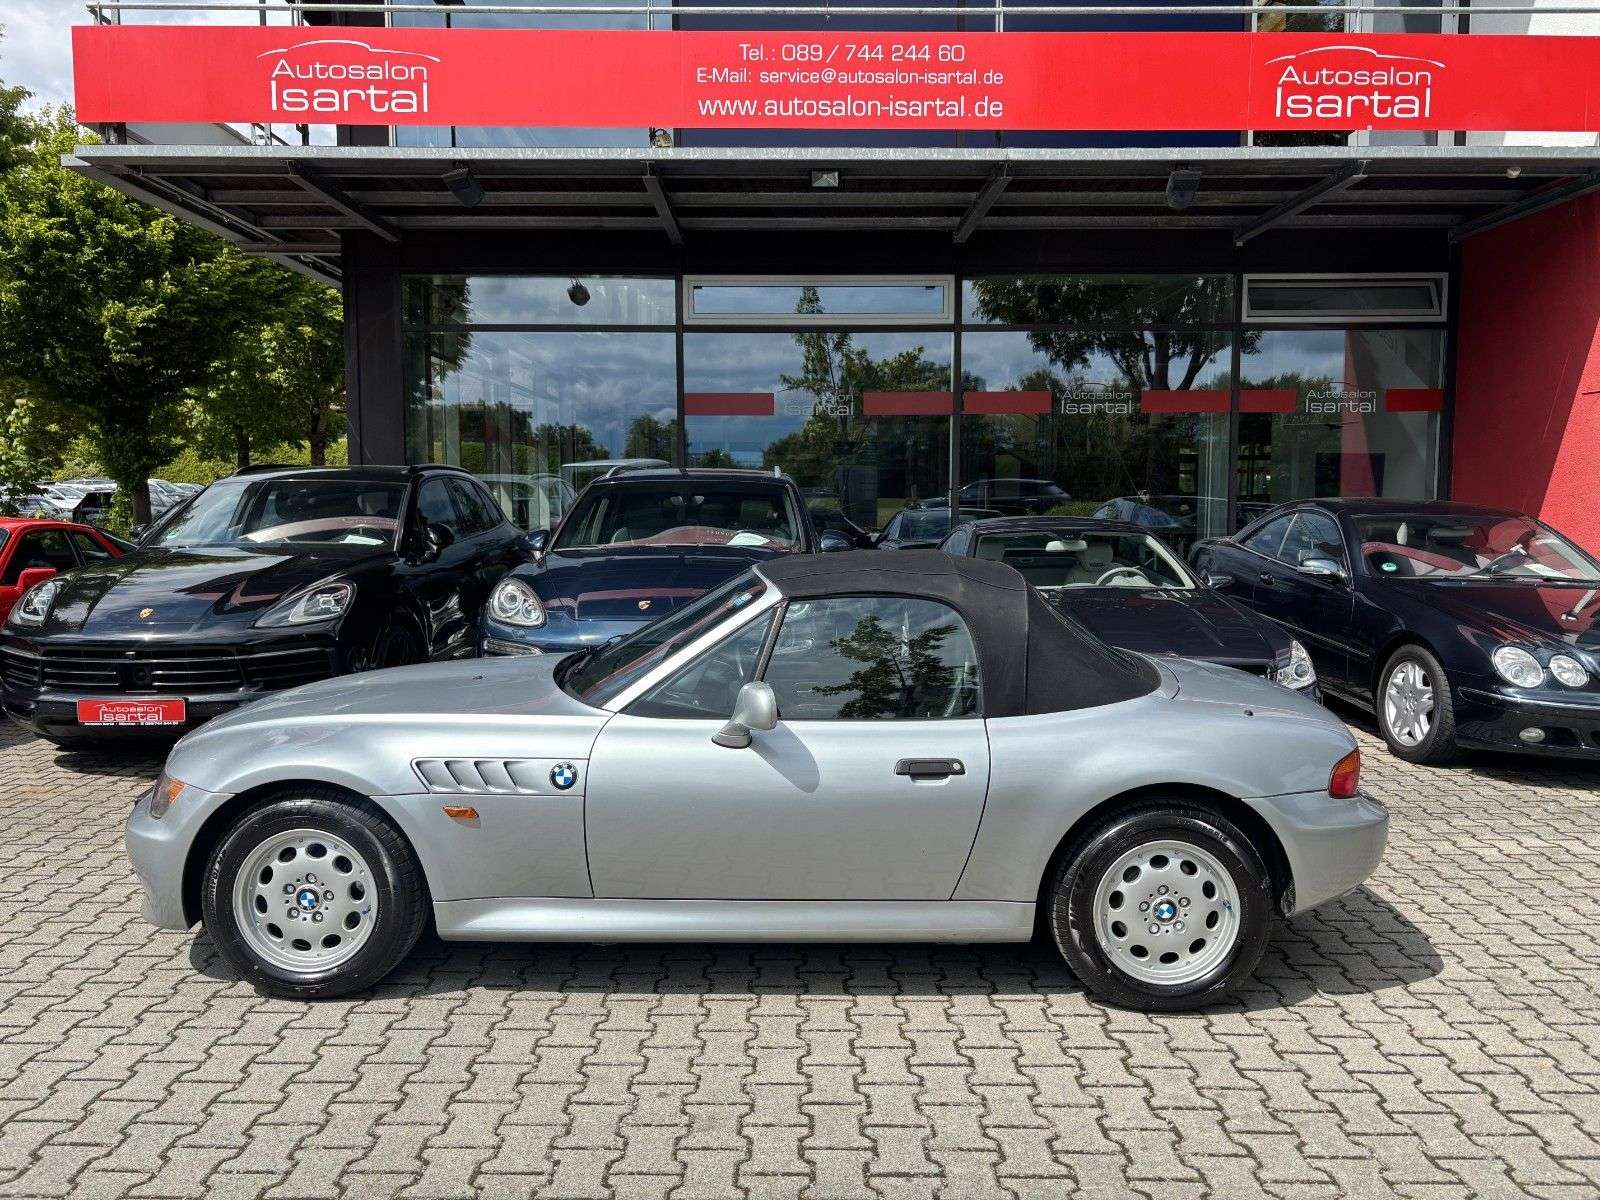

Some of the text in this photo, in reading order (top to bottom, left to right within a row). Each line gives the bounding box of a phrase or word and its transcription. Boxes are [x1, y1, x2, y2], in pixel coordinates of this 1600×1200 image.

[739, 43, 776, 61] Tel.:
[781, 44, 823, 61] 089
[845, 44, 884, 62] 744
[891, 44, 931, 62] 244
[938, 44, 966, 62] 60
[271, 59, 428, 81] Autosalon
[696, 67, 1004, 85] E-Mail: service@autosalon-isartal.de
[1278, 65, 1432, 86] Autosalon
[271, 80, 429, 113] Isartal
[698, 94, 1004, 117] www.autosalon-isartal.de
[1275, 86, 1431, 118] Isartal
[1062, 388, 1132, 400] Autosalon
[1306, 388, 1377, 399] Autosalon
[1061, 400, 1132, 414] Isartal
[1305, 399, 1377, 413] Isartal
